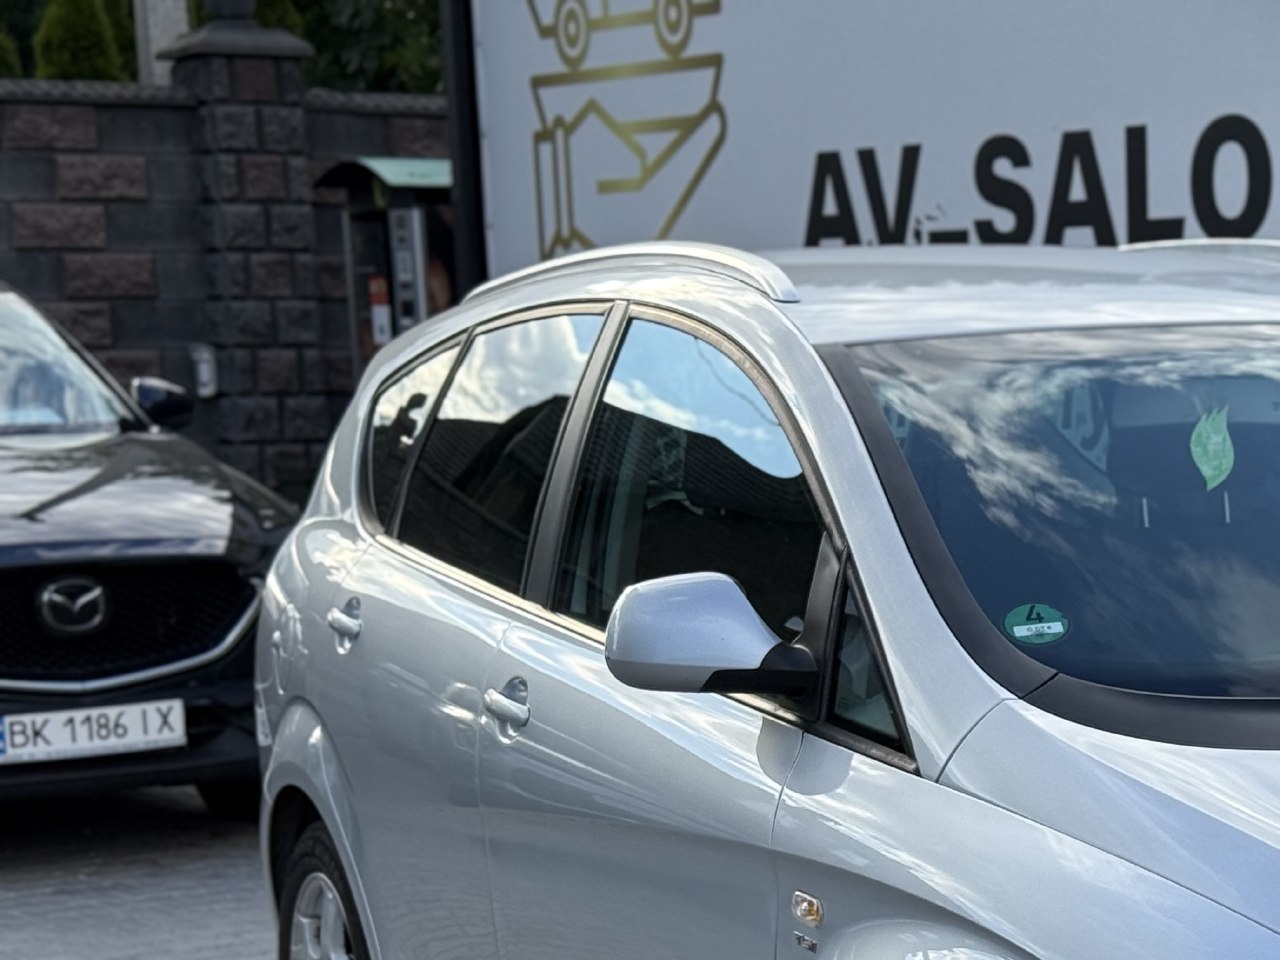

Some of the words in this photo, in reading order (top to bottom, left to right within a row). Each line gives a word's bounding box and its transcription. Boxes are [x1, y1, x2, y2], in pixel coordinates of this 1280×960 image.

[1026, 604, 1045, 623] 4
[9, 719, 52, 749] BK
[63, 710, 129, 744] 1186
[141, 704, 175, 736] IX
